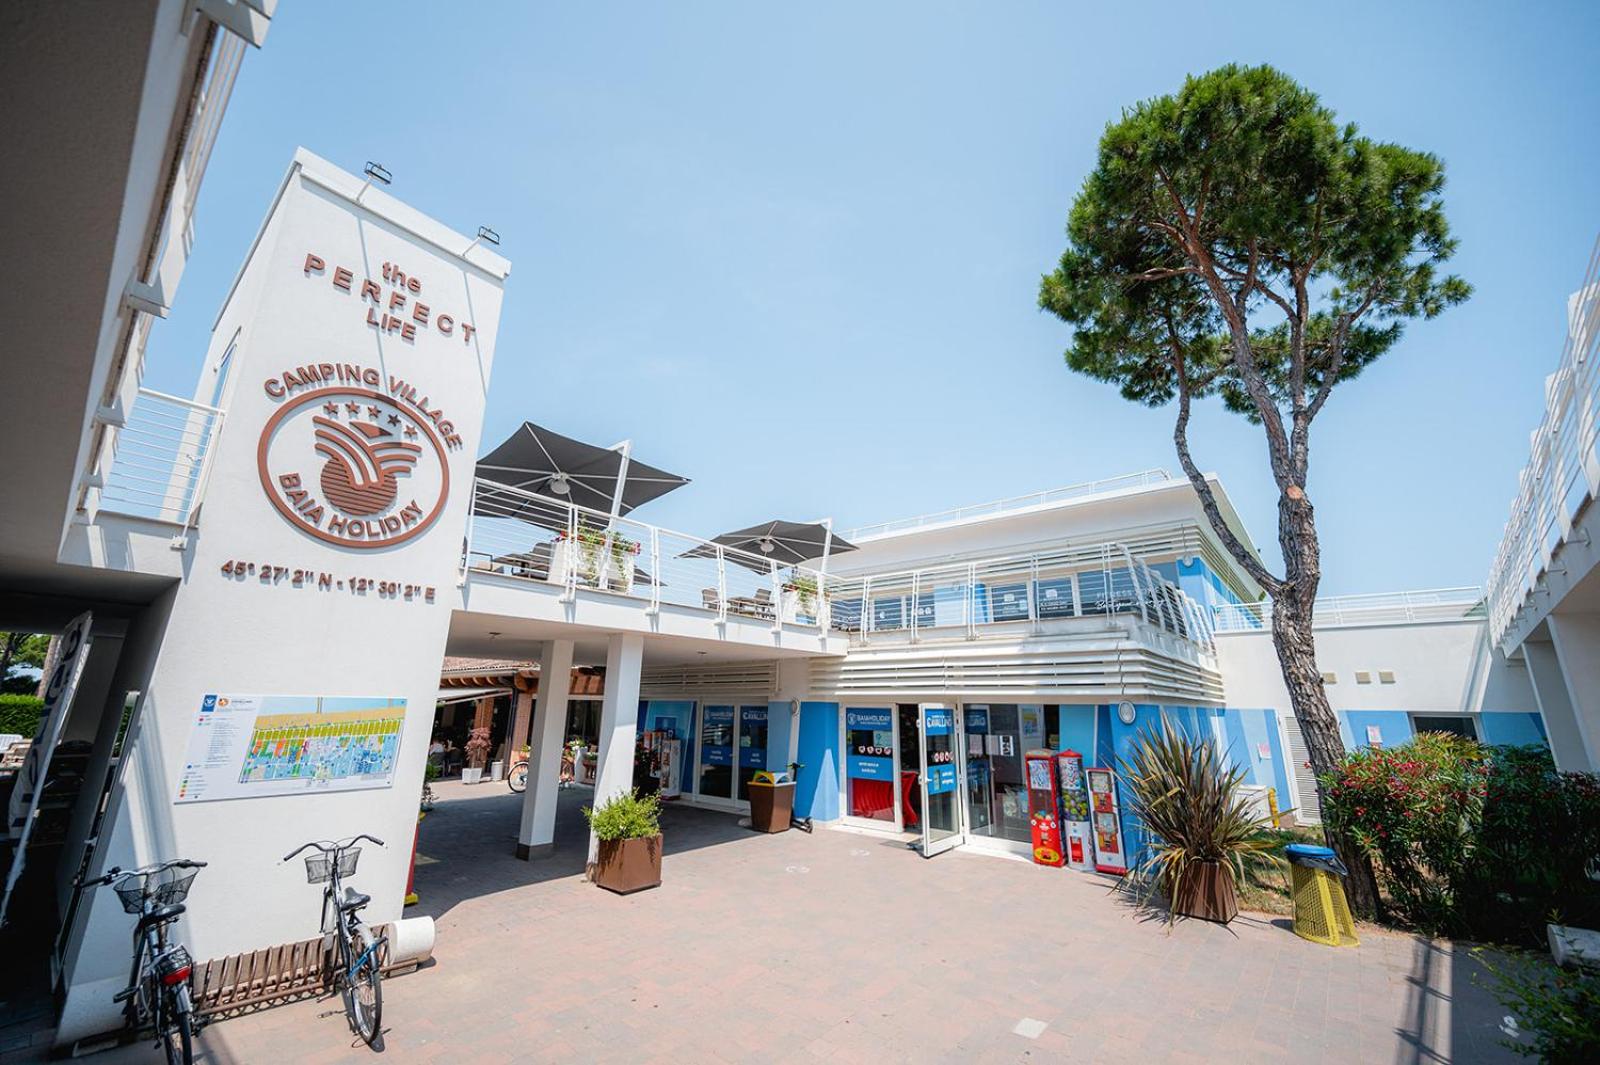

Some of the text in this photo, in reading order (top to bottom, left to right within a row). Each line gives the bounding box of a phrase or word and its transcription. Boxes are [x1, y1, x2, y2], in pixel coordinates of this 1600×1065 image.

[304, 253, 476, 342] PERFECT
[382, 261, 422, 293] the
[367, 307, 416, 341] LIFE
[263, 363, 463, 450] CAMPING VILLAGE
[278, 472, 424, 538] BAIA HOLIDAY
[319, 573, 333, 589] N
[425, 588, 436, 601] E
